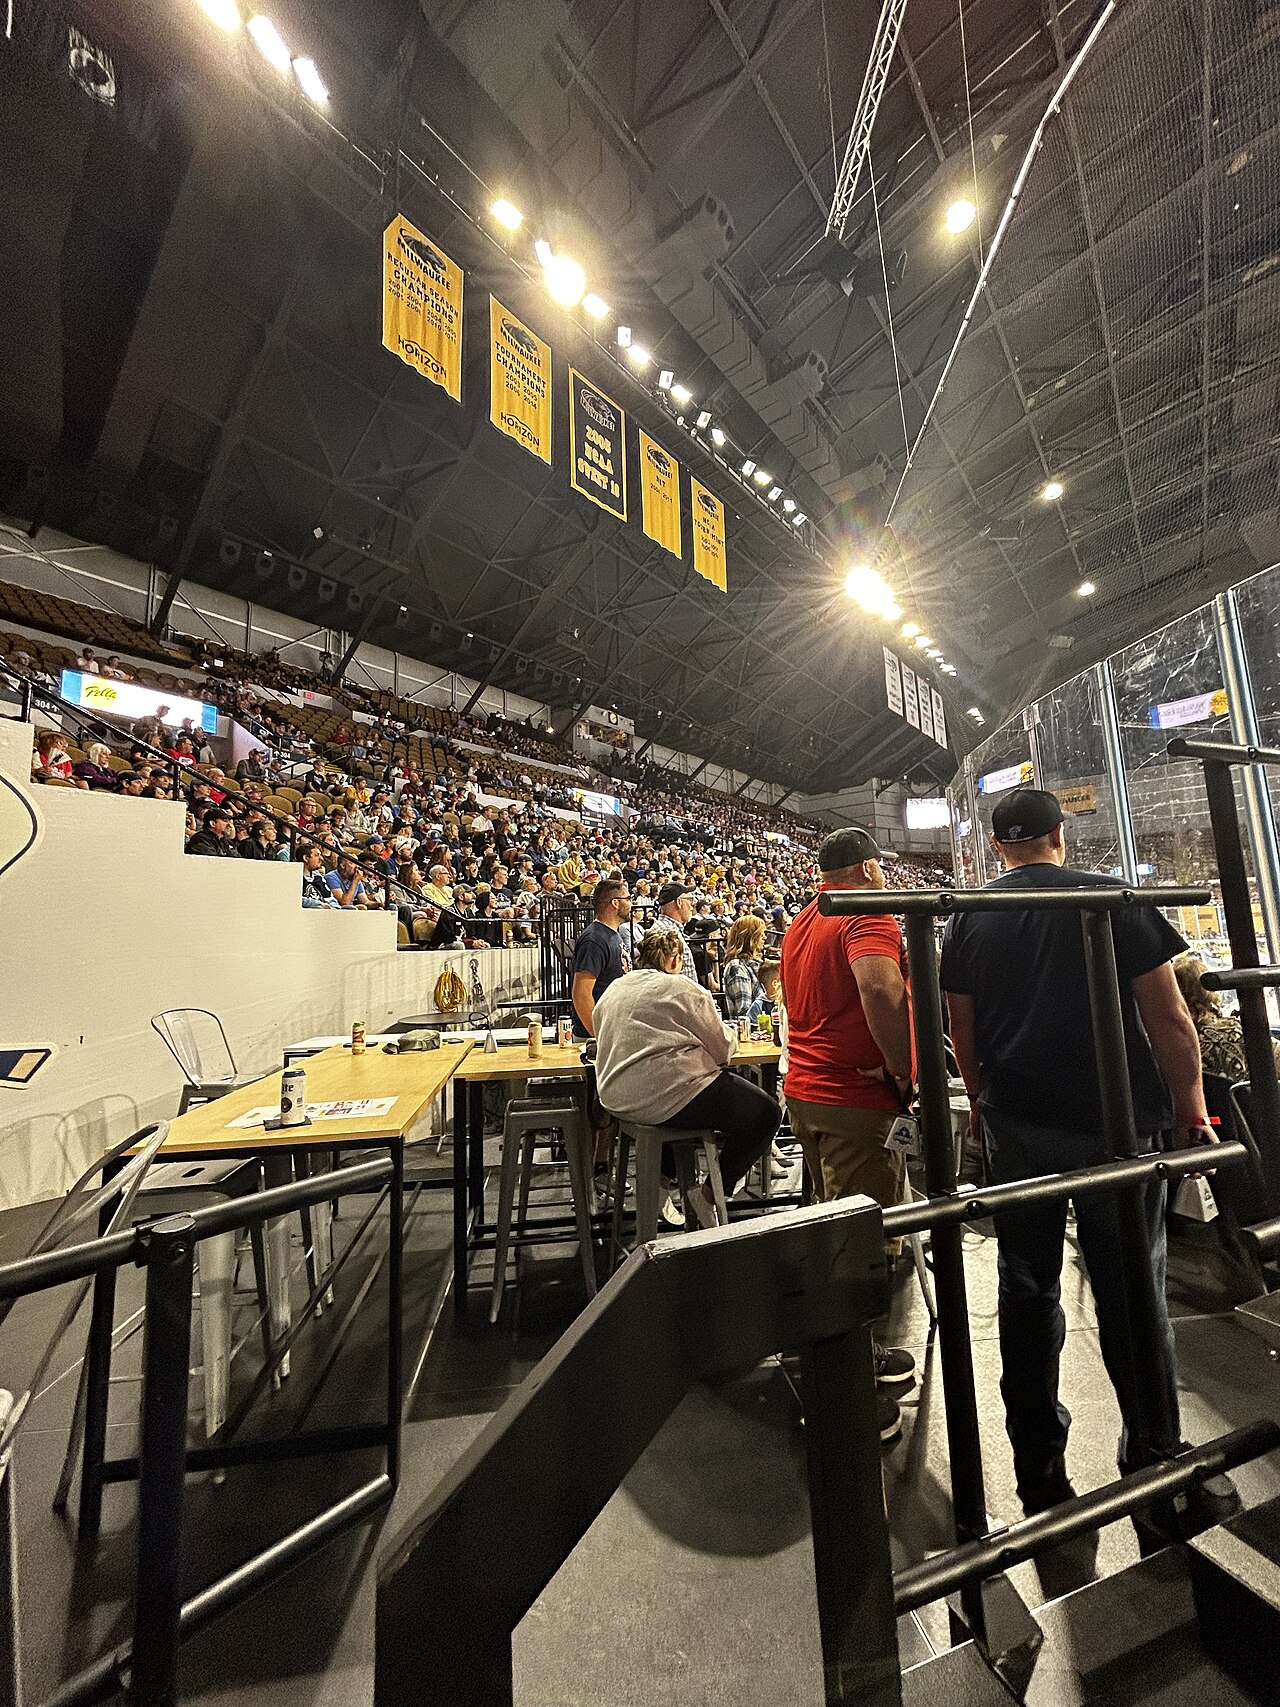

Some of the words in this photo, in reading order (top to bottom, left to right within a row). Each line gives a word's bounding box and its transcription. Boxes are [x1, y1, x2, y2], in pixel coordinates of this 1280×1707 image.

[397, 236, 451, 291] MILWAUKEE
[387, 252, 427, 290] REGULAR
[429, 287, 459, 318] SEASON
[394, 270, 454, 324] CHAMPIONS
[397, 334, 447, 378] HORIZON
[495, 341, 546, 388] TOURNAMENT
[500, 326, 542, 367] MILWAUKEE
[496, 353, 546, 398] CHAMPIONS
[500, 412, 540, 446] HORIZON
[584, 441, 614, 475] NCAA
[35, 699, 50, 710] 304
[85, 685, 116, 699] Pella
[282, 1083, 294, 1094] ite
